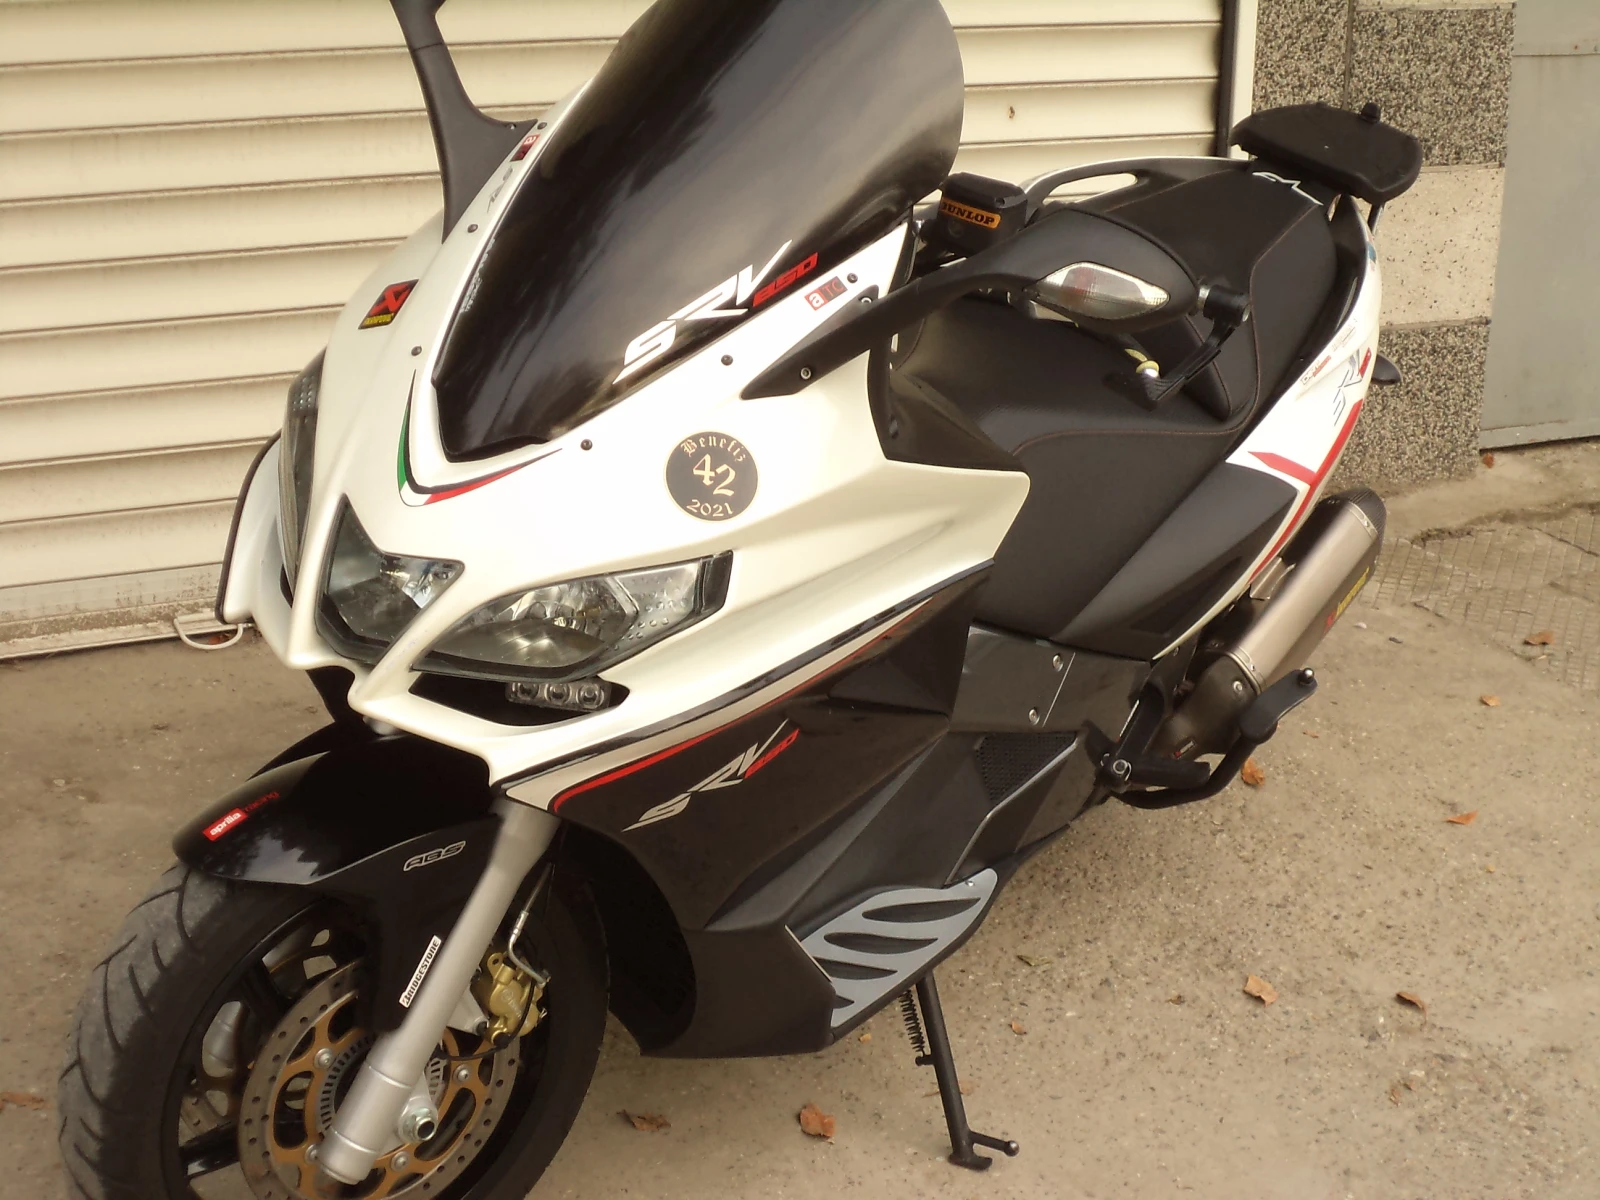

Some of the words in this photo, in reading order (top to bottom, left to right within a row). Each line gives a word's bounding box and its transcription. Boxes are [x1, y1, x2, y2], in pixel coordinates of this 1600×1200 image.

[612, 240, 793, 385] SRV
[692, 453, 736, 497] 42
[686, 499, 733, 517] 2021
[621, 718, 789, 833] SRV
[209, 812, 242, 836] aprilia
[403, 840, 467, 872] ABS
[402, 939, 440, 1006] BRIDGESTONE
